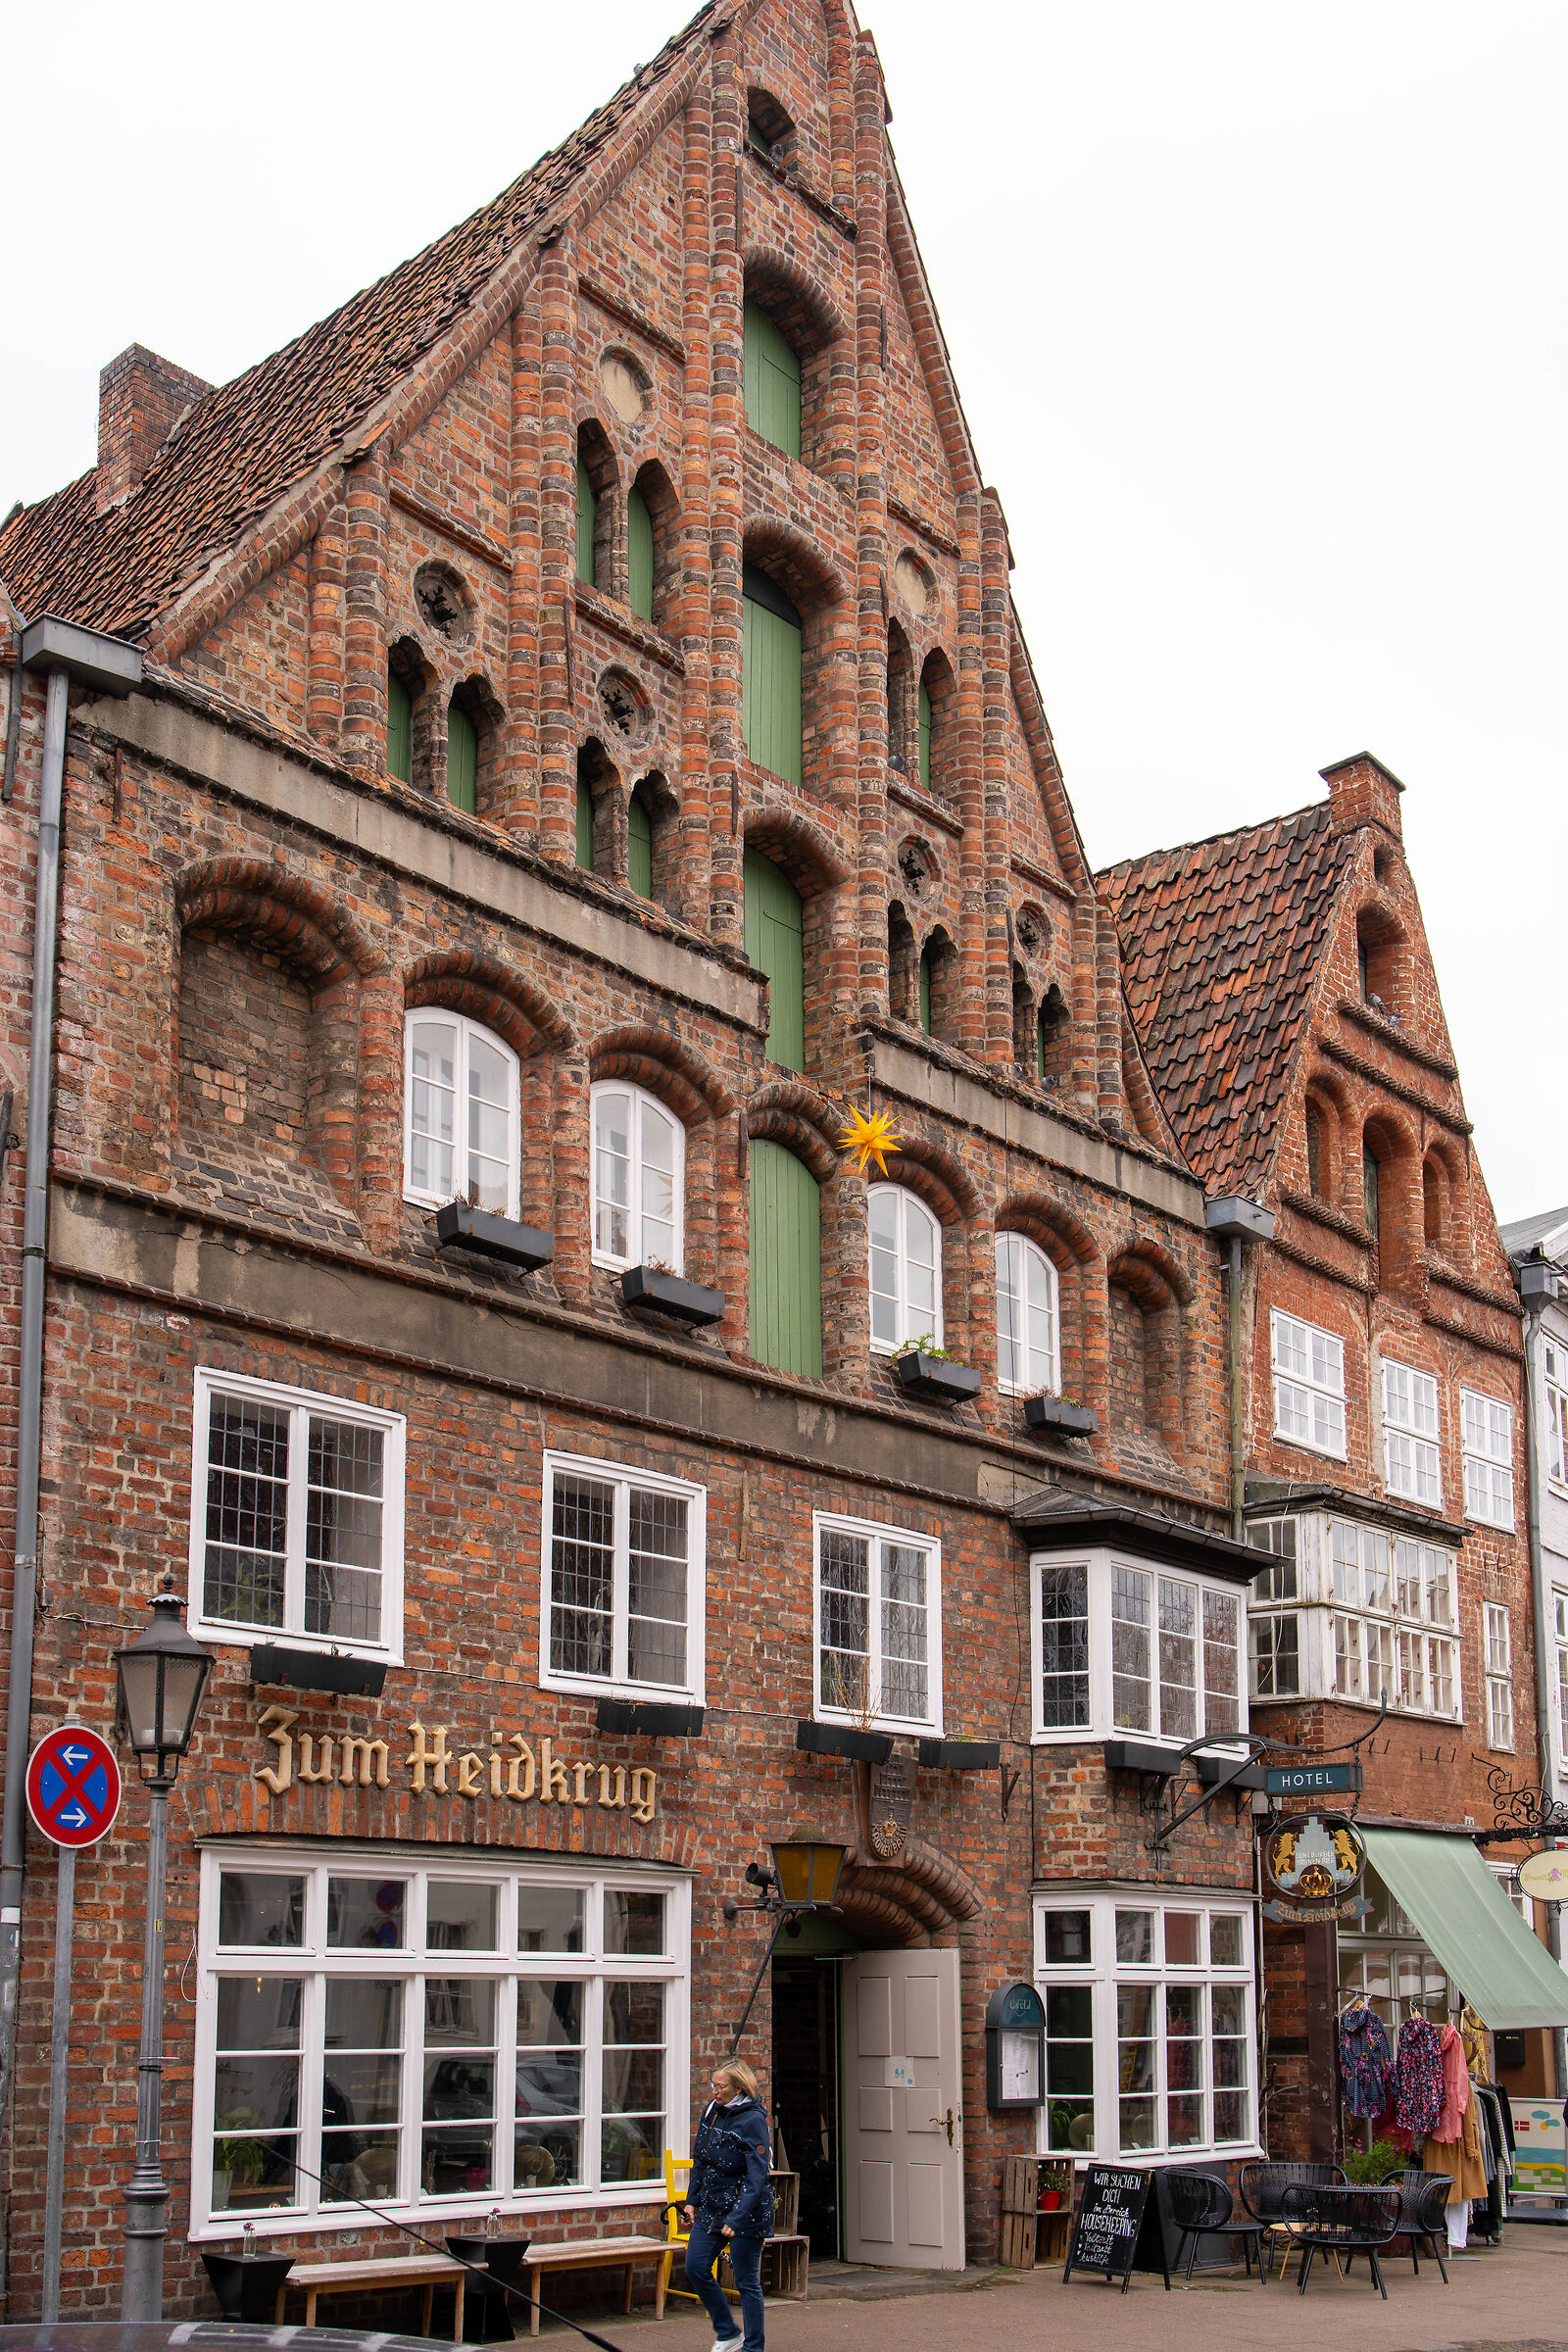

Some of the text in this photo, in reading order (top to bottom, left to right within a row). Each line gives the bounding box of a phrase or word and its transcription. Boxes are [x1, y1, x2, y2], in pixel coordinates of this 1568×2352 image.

[254, 1704, 658, 1826] Zum Heidkrug
[1282, 1773, 1333, 1787] HOTEL
[1094, 2172, 1142, 2190] WIR SUCHEN
[1102, 2188, 1122, 2204] DICH
[1080, 2213, 1138, 2237] HOUSEKEEPING
